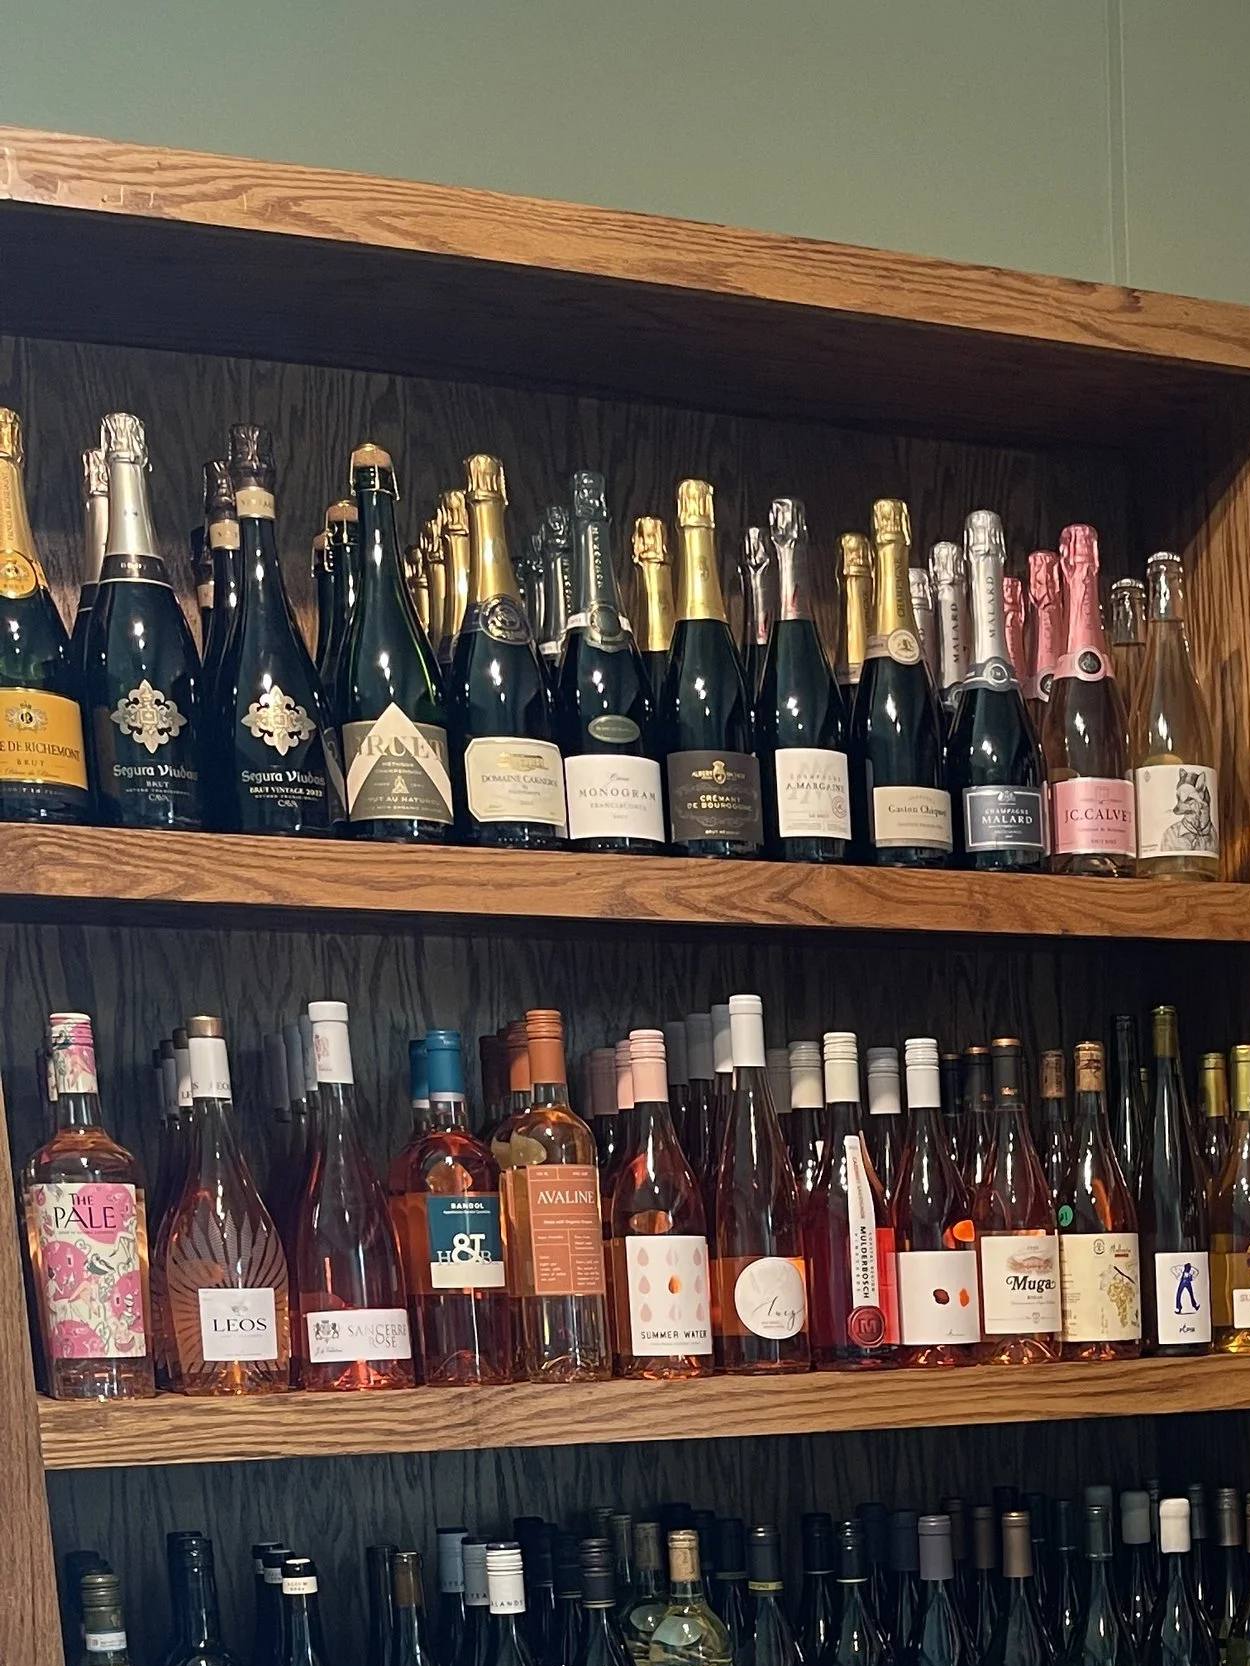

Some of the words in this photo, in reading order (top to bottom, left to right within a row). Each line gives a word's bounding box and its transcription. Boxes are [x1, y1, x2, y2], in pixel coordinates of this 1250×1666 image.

[8, 741, 22, 752] DE
[26, 742, 81, 762] RICHEMONT
[17, 759, 46, 767] BRUT
[113, 764, 155, 780] Segura
[241, 770, 284, 784] Segura
[287, 770, 326, 786] Viudas
[578, 787, 657, 801] MONOGRAM
[888, 803, 918, 814] Gaston
[981, 815, 1033, 825] MALARD
[68, 1193, 95, 1206] THE
[537, 1190, 595, 1205] AVALINE
[53, 1206, 117, 1229] PALE
[860, 1226, 870, 1299] MULDERBOSCH
[1005, 1275, 1057, 1291] Muga
[212, 1318, 267, 1333] LEOS
[859, 1318, 877, 1335] M
[640, 1330, 680, 1340] SUMMER
[683, 1330, 708, 1340] WATER
